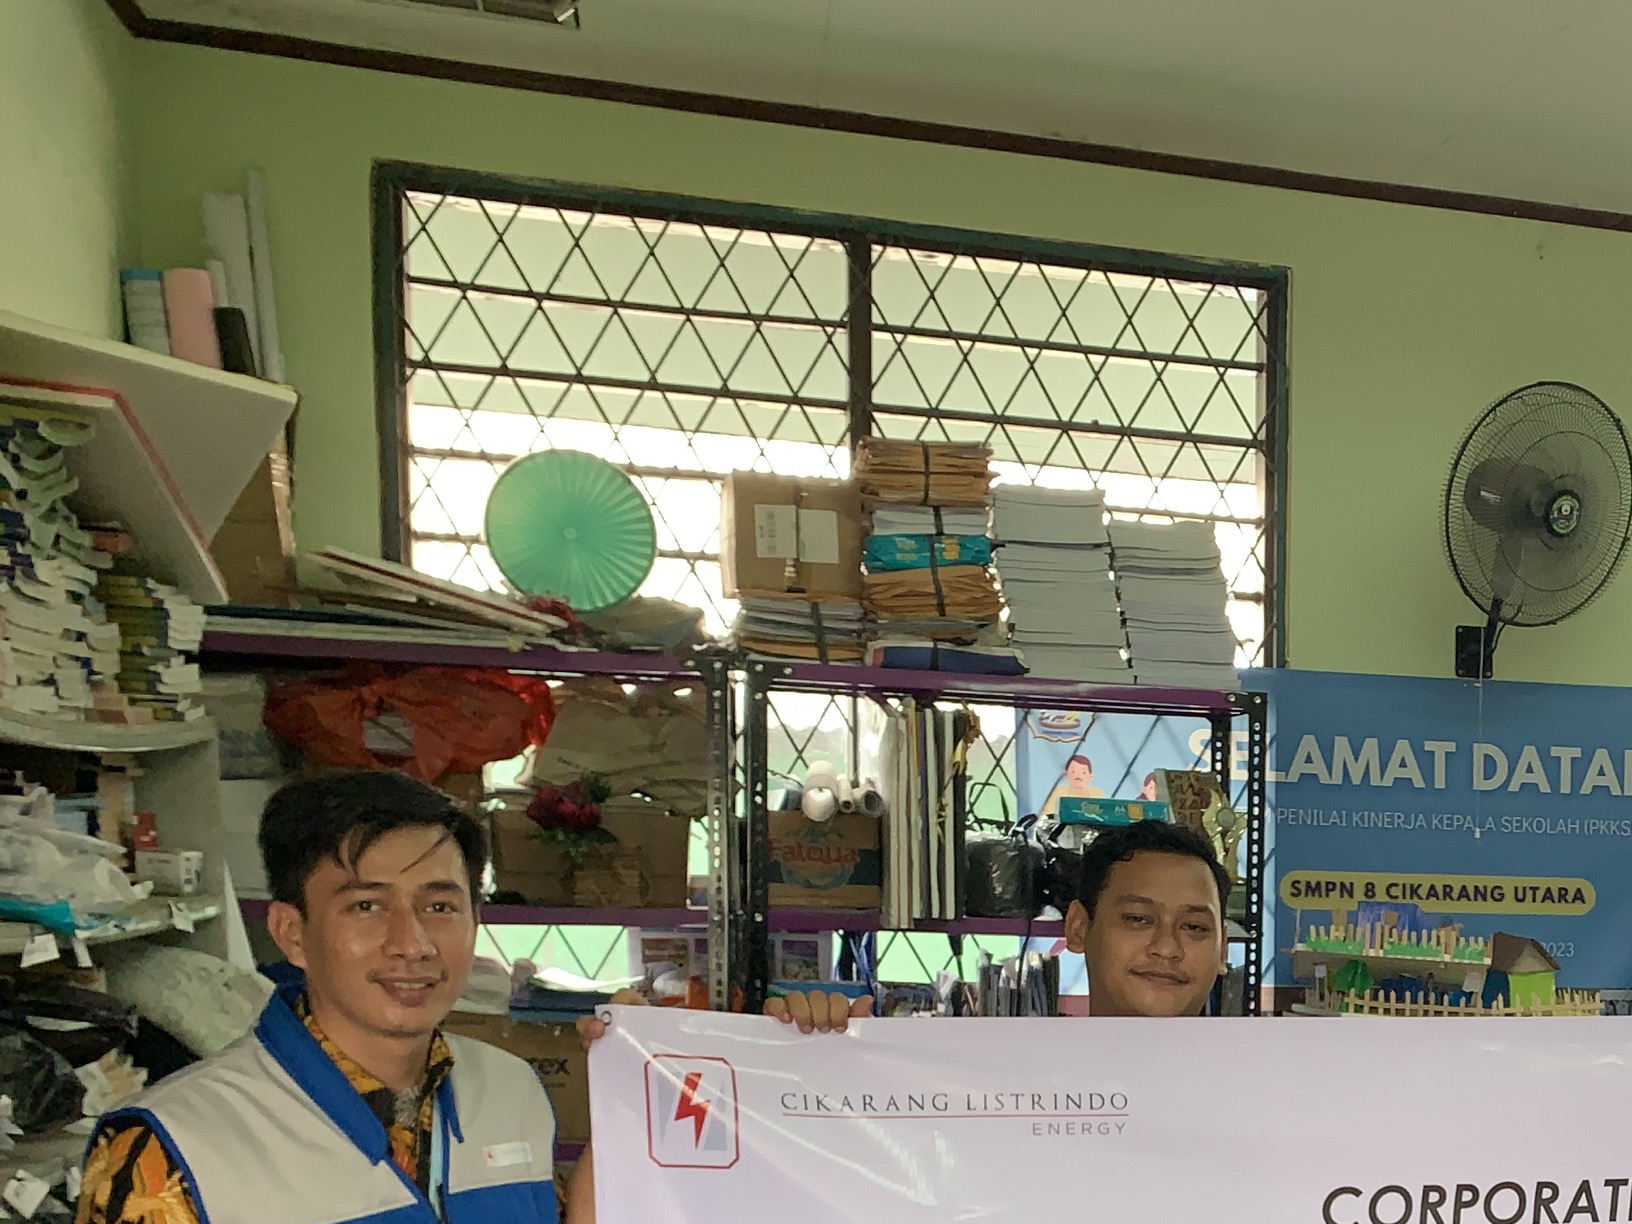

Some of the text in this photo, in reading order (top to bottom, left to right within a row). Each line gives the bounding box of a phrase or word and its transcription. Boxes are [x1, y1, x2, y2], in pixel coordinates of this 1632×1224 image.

[1188, 728, 1457, 790] SELAMAT
[1277, 808, 1348, 828] PENILAI
[1352, 811, 1427, 831] KINERJA
[1432, 813, 1497, 832] KEPALA
[1501, 817, 1580, 836] SEKOLAH
[1290, 880, 1587, 905] SMPN 8 CIKARANG UTARA
[781, 1092, 1129, 1113] CIKARANG LISTRINDO
[1032, 1122, 1127, 1136] ENERGY
